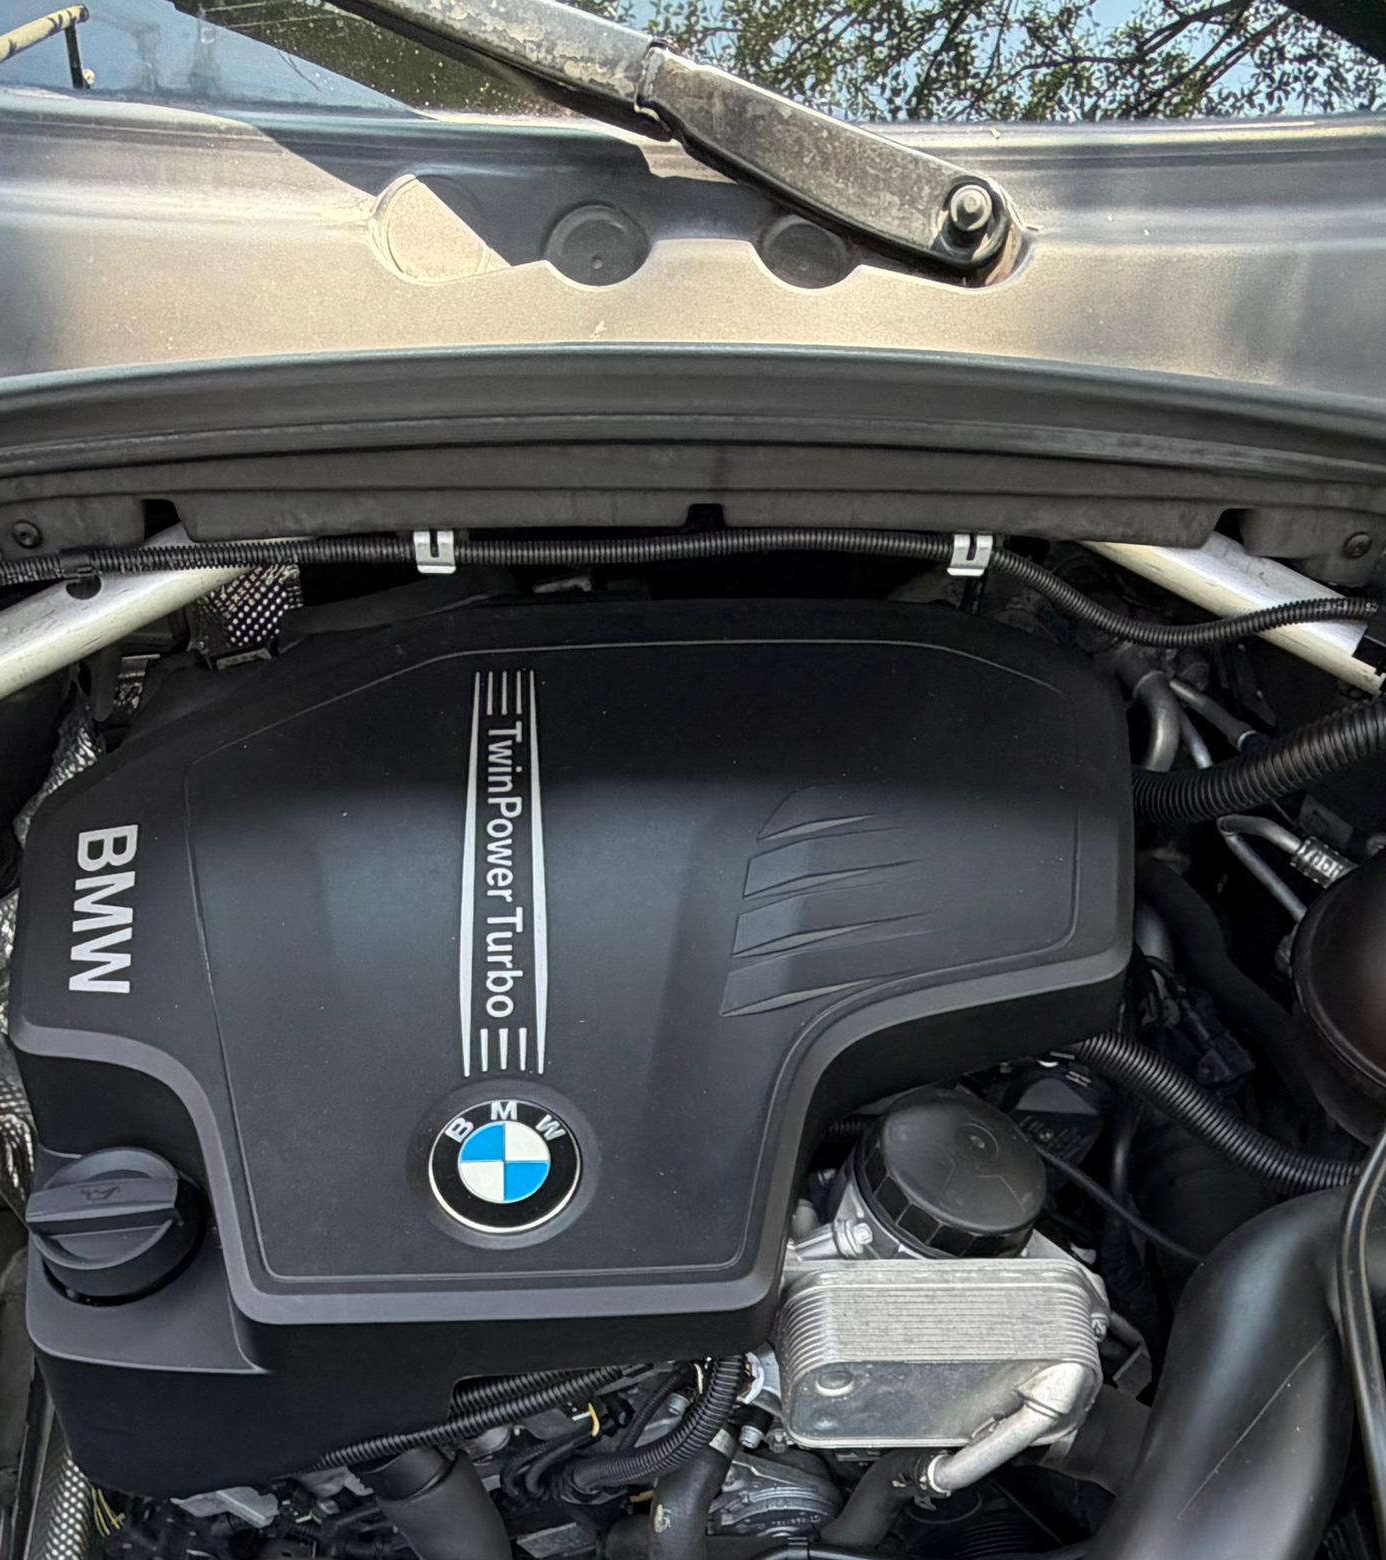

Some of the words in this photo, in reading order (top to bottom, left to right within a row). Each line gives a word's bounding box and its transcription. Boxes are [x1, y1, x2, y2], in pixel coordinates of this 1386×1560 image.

[486, 721, 523, 902] TwinPower
[69, 824, 138, 994] BMW
[486, 907, 524, 1018] Turbo
[445, 1101, 566, 1143] BMW
